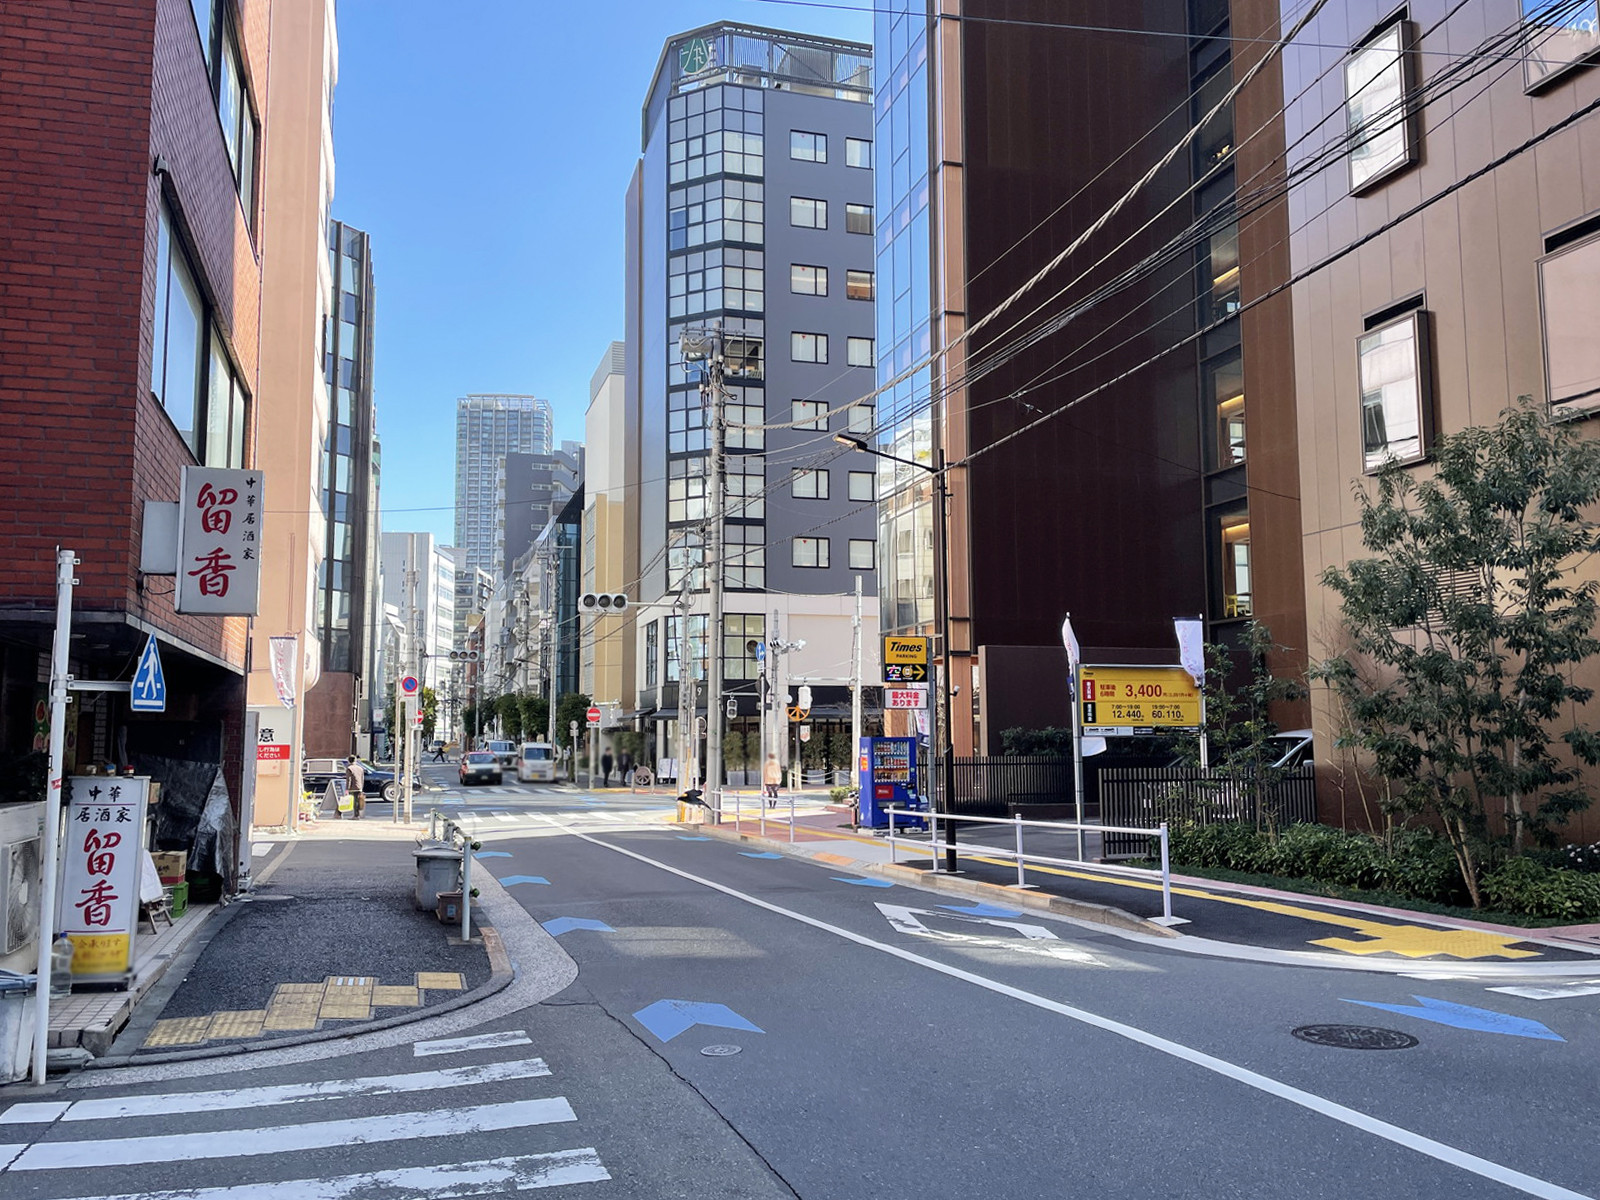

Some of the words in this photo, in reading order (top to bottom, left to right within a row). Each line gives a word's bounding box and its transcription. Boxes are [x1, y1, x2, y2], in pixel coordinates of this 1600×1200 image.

[242, 477, 256, 560] 中華居酒家
[187, 482, 239, 598] 留香
[890, 641, 923, 652] Times
[886, 665, 901, 680] 空
[892, 691, 920, 699] 最大料金
[1125, 684, 1162, 699] 3,400
[892, 699, 920, 707] あります
[88, 785, 122, 803] 中華
[74, 806, 132, 823] 居酒家
[74, 828, 122, 926] 留香
